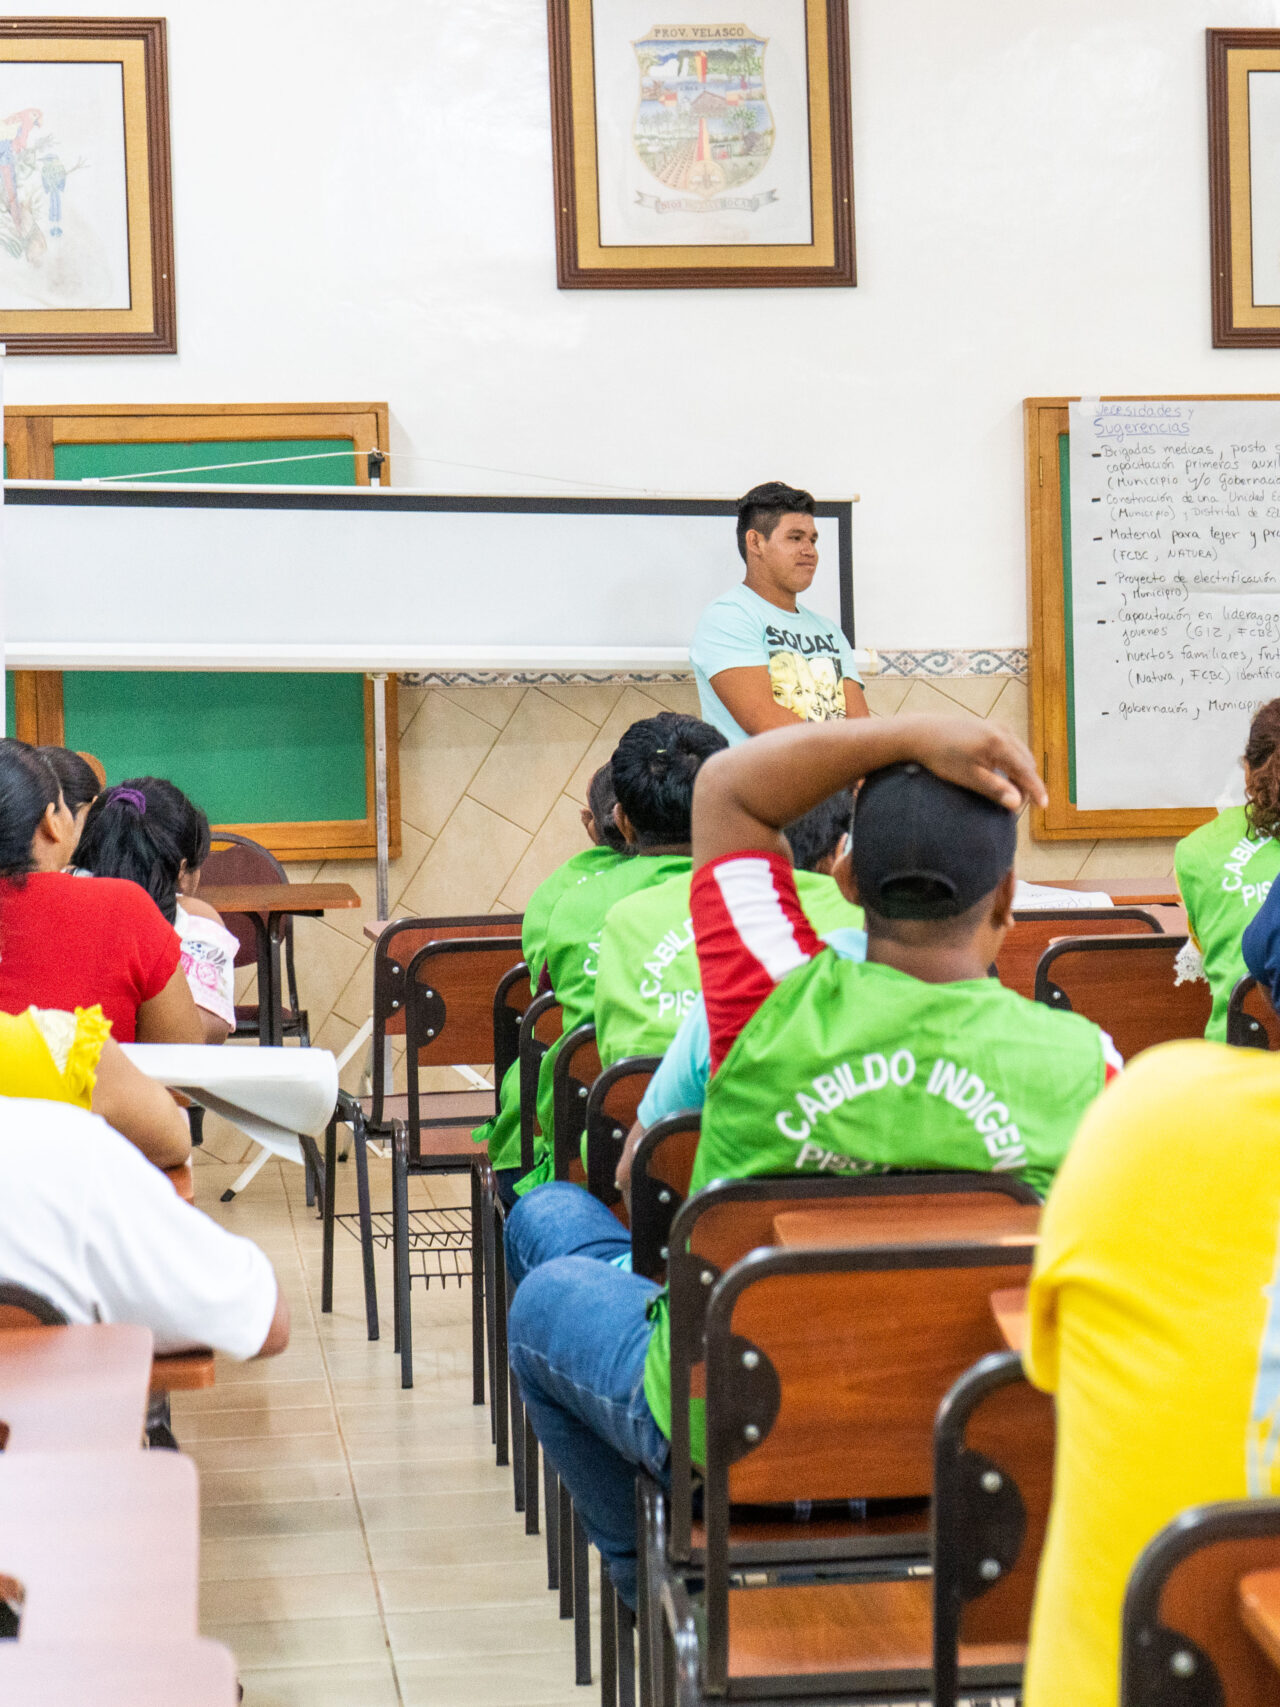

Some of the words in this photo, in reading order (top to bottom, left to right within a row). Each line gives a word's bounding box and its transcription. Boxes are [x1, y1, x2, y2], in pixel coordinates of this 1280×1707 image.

[692, 27, 745, 38] VELASCO
[1093, 417, 1191, 443] Sugerencias
[1101, 444, 1157, 461] Brigadas
[1230, 440, 1267, 459] posta
[1185, 458, 1241, 475] primeros
[1188, 472, 1212, 490] y/o
[1182, 493, 1193, 504] de
[1247, 506, 1259, 518] de
[1110, 527, 1161, 540] Material
[1171, 529, 1200, 544] para
[1210, 525, 1240, 545] tejer
[1250, 530, 1257, 549] y
[1115, 570, 1167, 591] Proyecto
[1173, 569, 1187, 584] de
[1198, 610, 1213, 621] en
[1222, 605, 1280, 631] liderazgo
[1126, 647, 1174, 661] huertos
[1222, 828, 1273, 891] CABIL
[640, 917, 696, 998] CABIL
[776, 1049, 916, 1141] CABILDO
[927, 1057, 1028, 1172] INDIGEN
